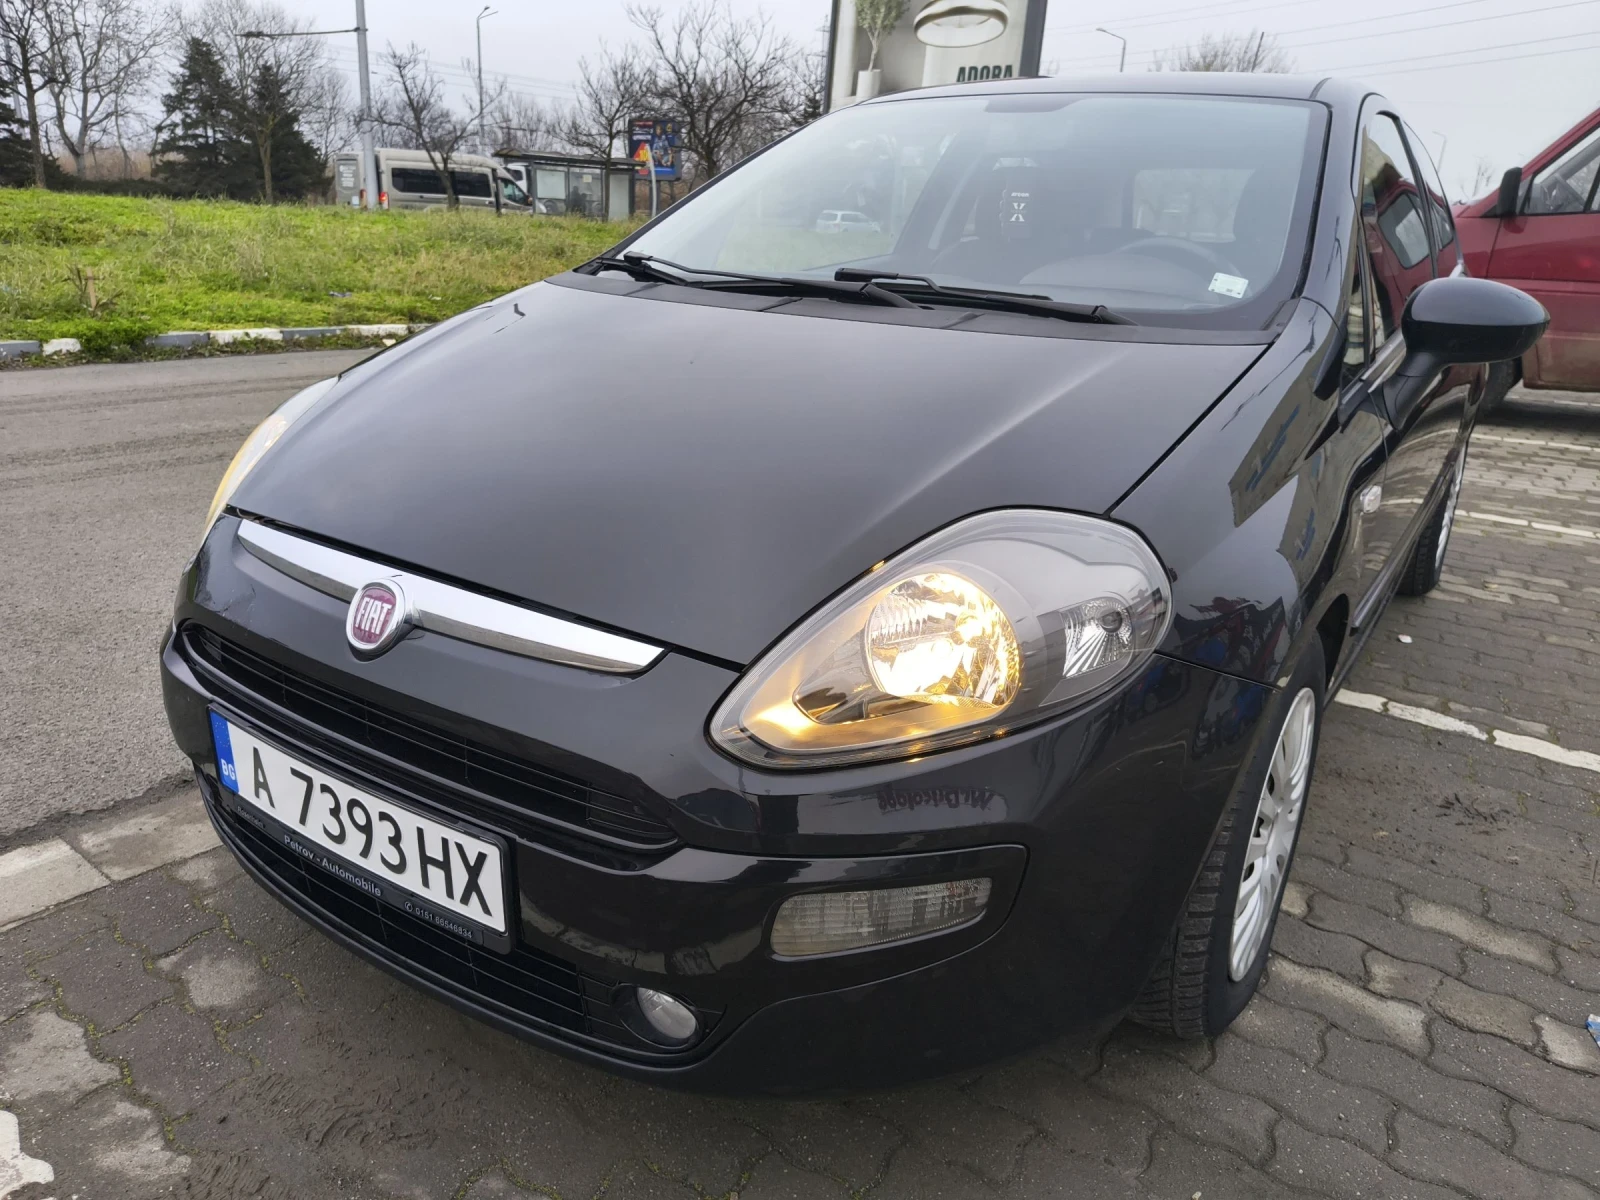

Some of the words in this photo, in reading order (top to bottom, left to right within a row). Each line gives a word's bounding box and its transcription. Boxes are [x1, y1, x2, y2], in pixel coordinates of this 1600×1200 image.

[355, 596, 393, 635] FIAT
[221, 758, 236, 780] BG
[253, 746, 276, 809] A
[290, 766, 407, 875] 7393
[416, 826, 493, 917] HX
[284, 834, 315, 860] Petrov
[322, 857, 382, 897] Automobile
